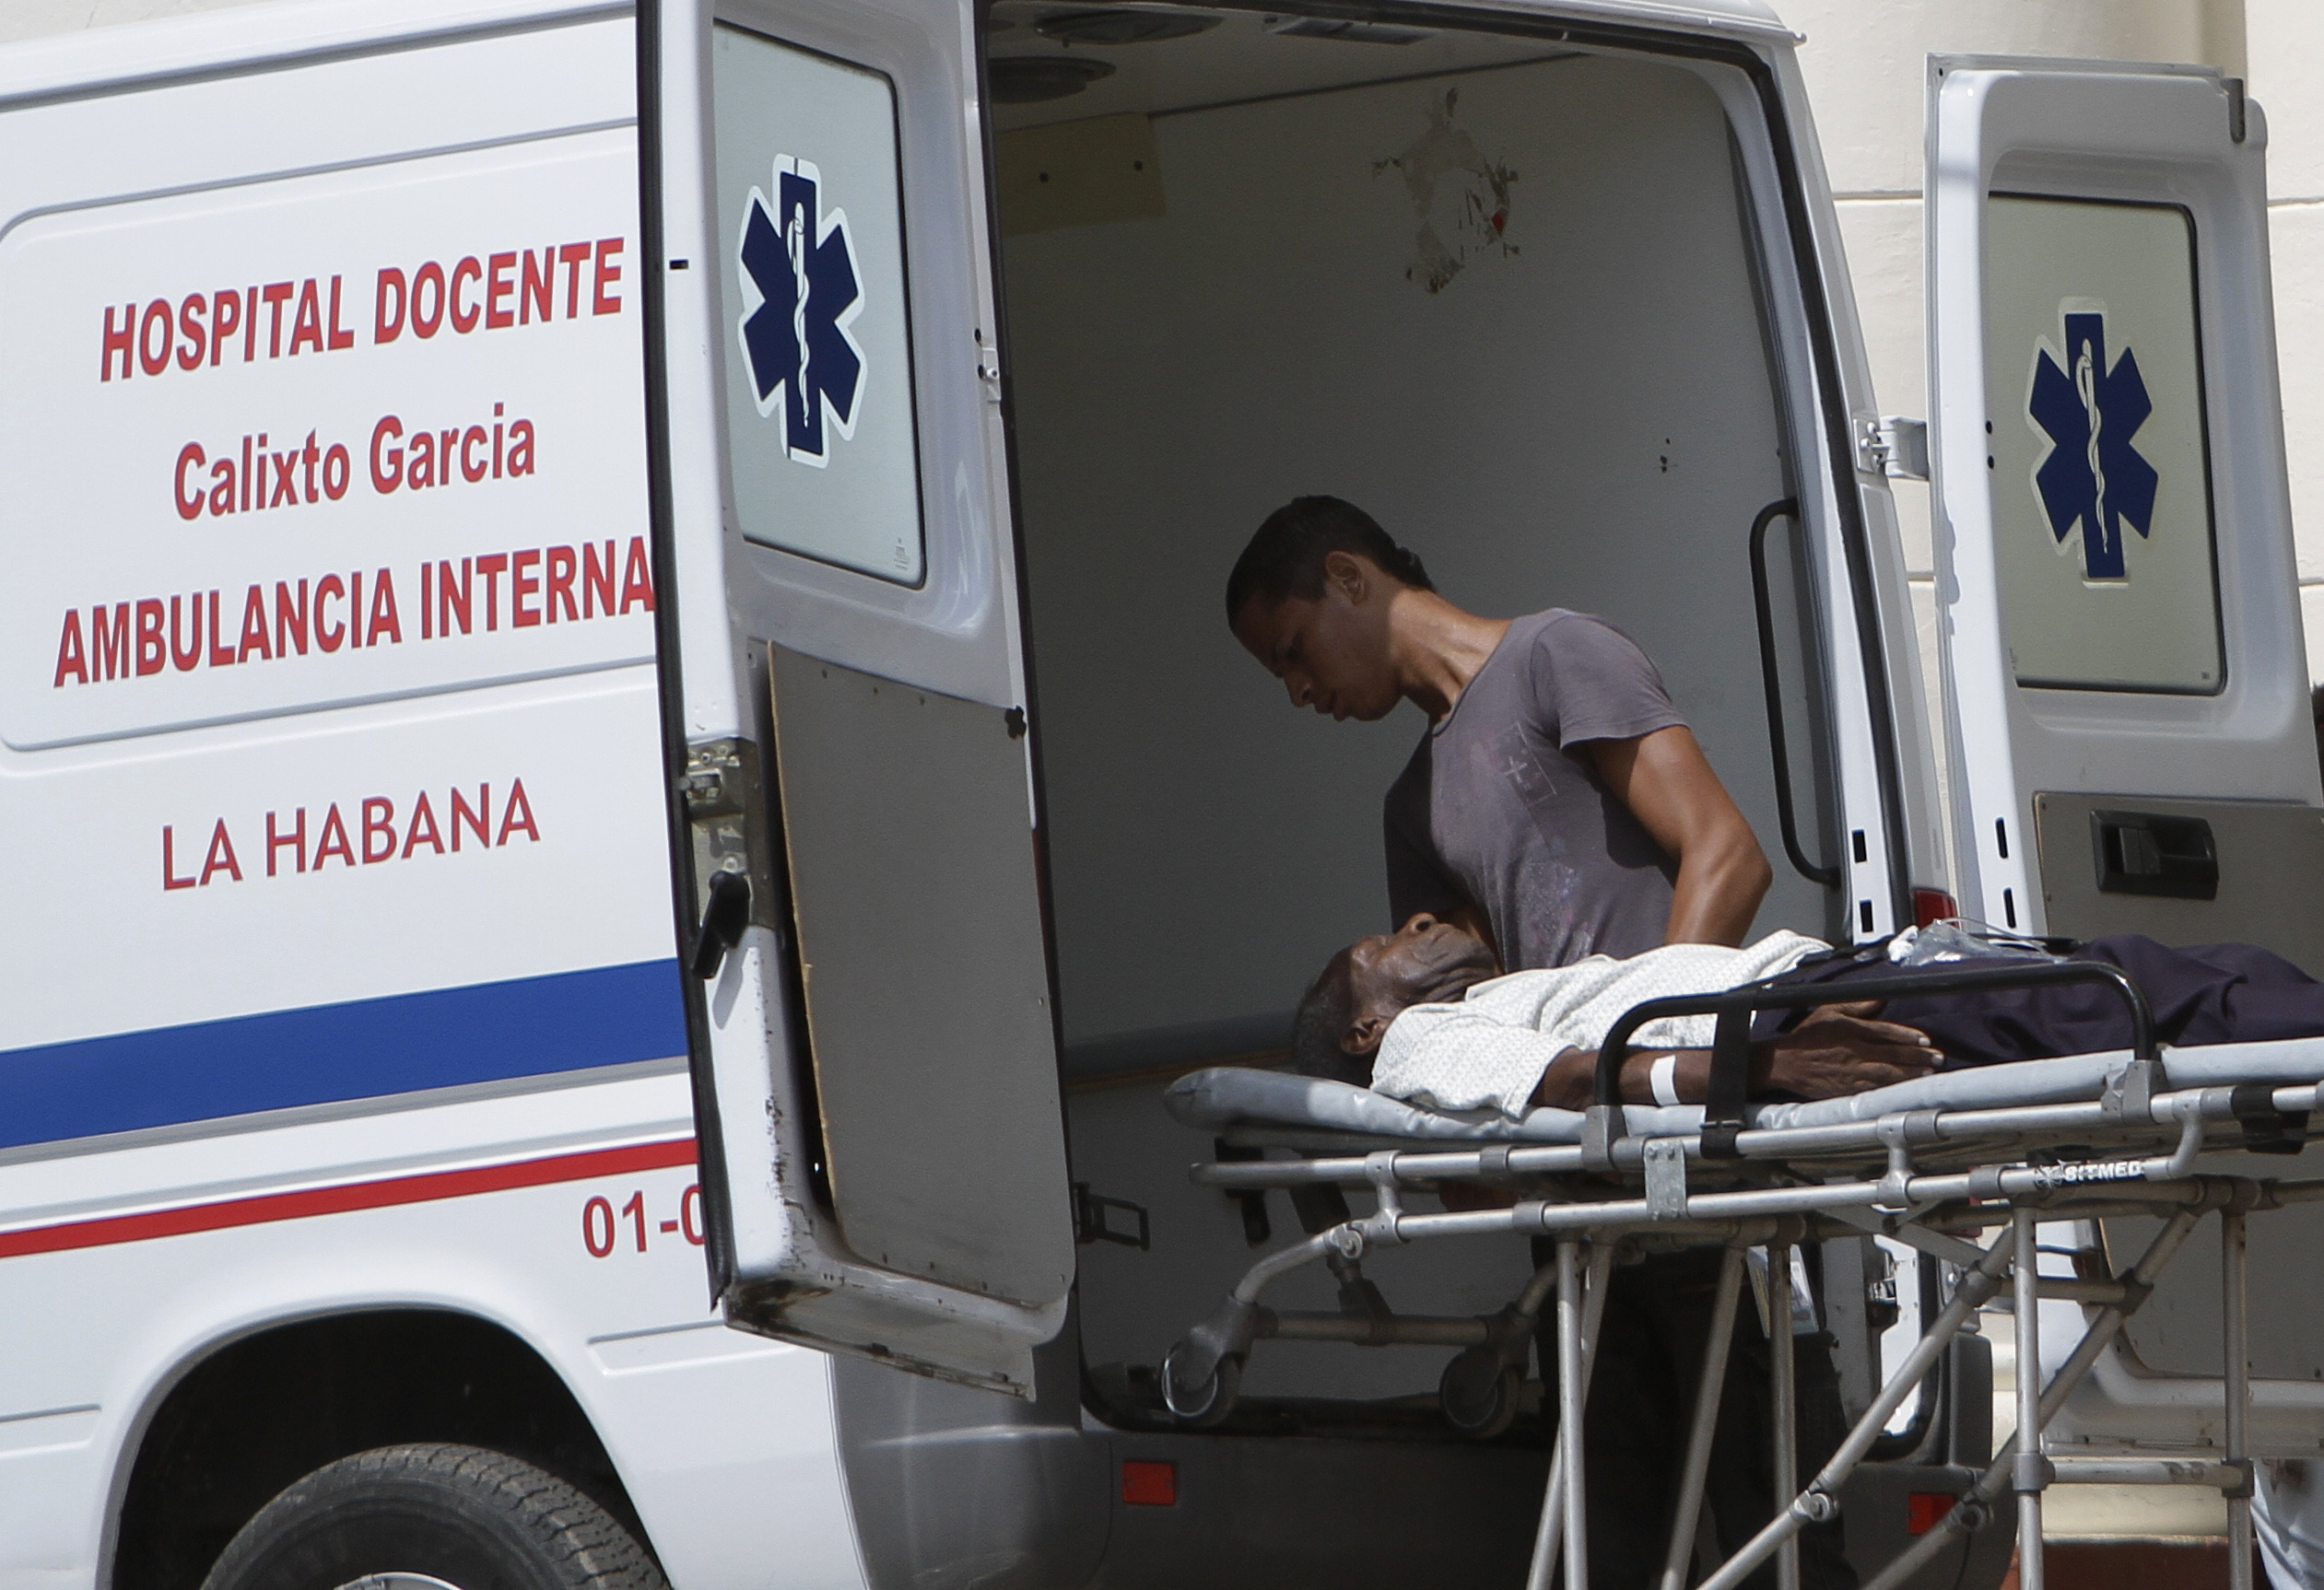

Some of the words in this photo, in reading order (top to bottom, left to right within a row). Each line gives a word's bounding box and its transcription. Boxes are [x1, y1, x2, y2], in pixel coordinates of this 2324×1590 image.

[102, 275, 355, 382] HOSPITAL
[375, 238, 625, 345] DOCENTE
[174, 429, 350, 520] Calixto
[370, 403, 534, 494] Garcia
[54, 567, 402, 688] AMBULANCIA
[421, 535, 656, 640] INTERNA
[163, 818, 242, 891] LA
[266, 777, 541, 876] HABANA
